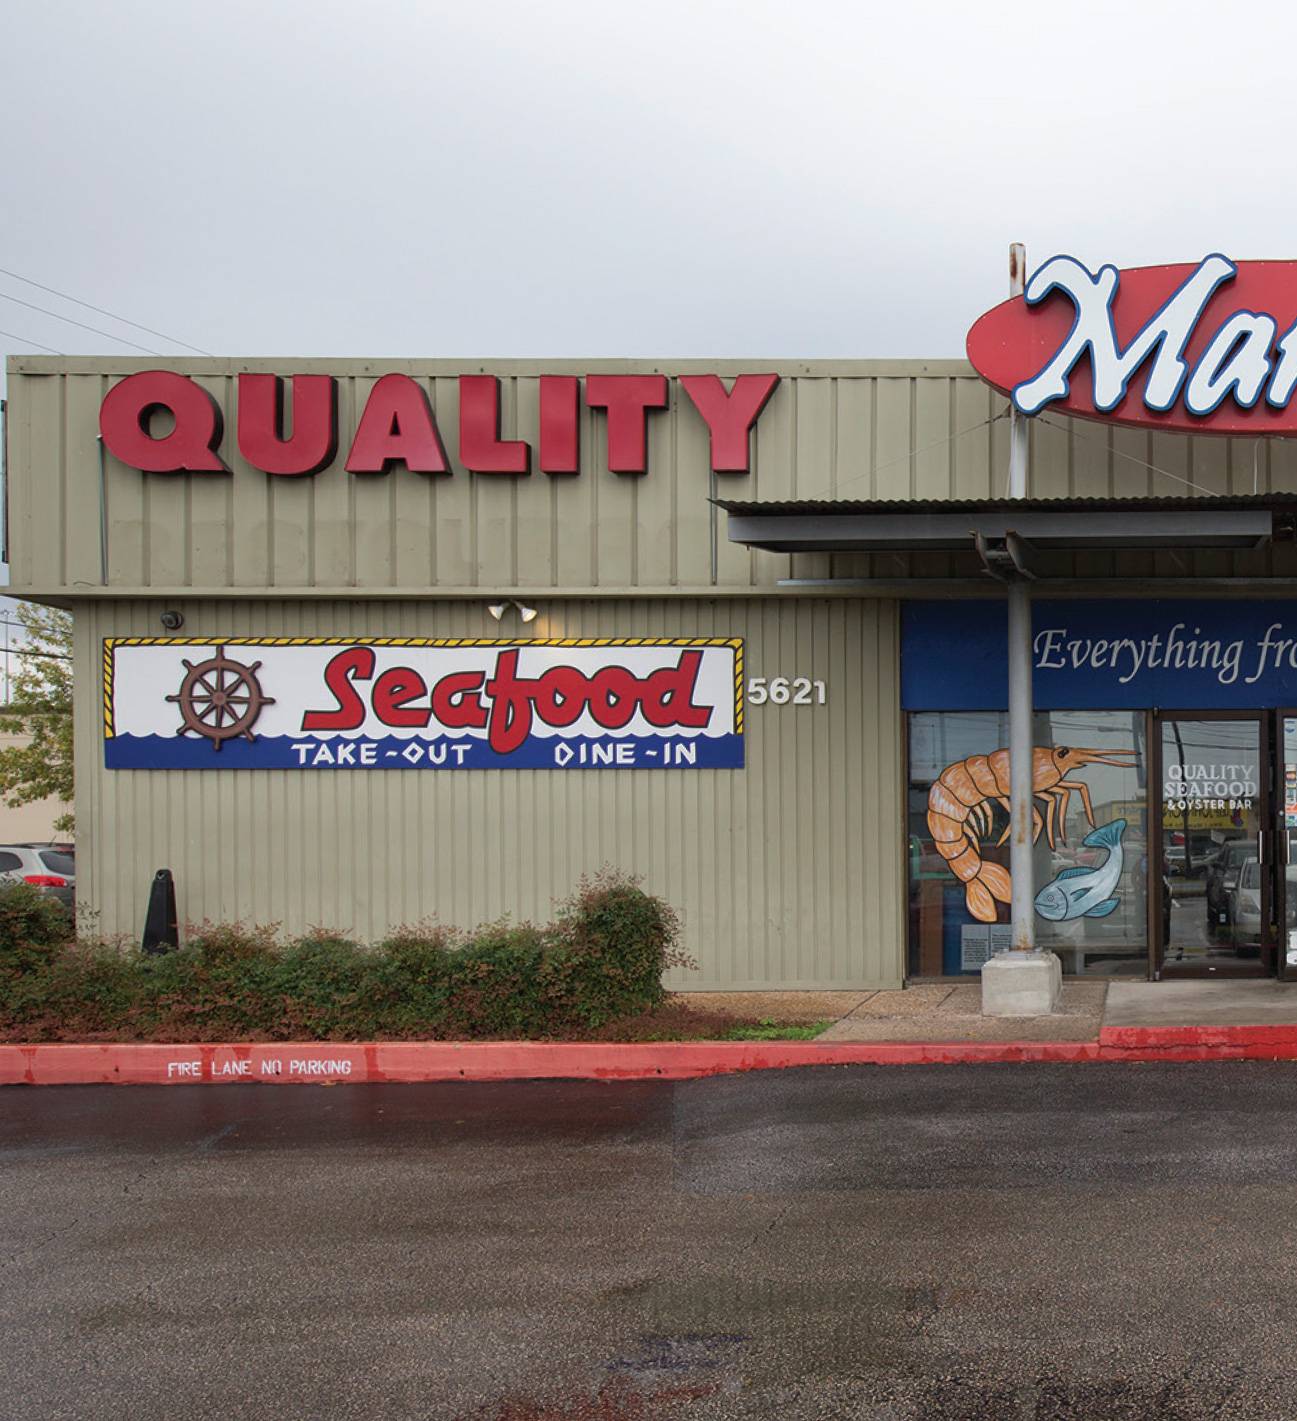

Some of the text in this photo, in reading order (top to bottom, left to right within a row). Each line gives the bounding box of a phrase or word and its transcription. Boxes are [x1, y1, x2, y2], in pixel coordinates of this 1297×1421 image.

[99, 370, 781, 475] QUALITY
[1033, 623, 1245, 684] Everything
[300, 646, 714, 755] Seafood
[748, 677, 827, 705] 5621
[1168, 764, 1254, 780] QUALITY
[1164, 781, 1257, 798] SEAFOOD
[1167, 799, 1252, 811] & OYSTER BAR
[168, 1059, 352, 1077] FIRE LANE NO PARKING
